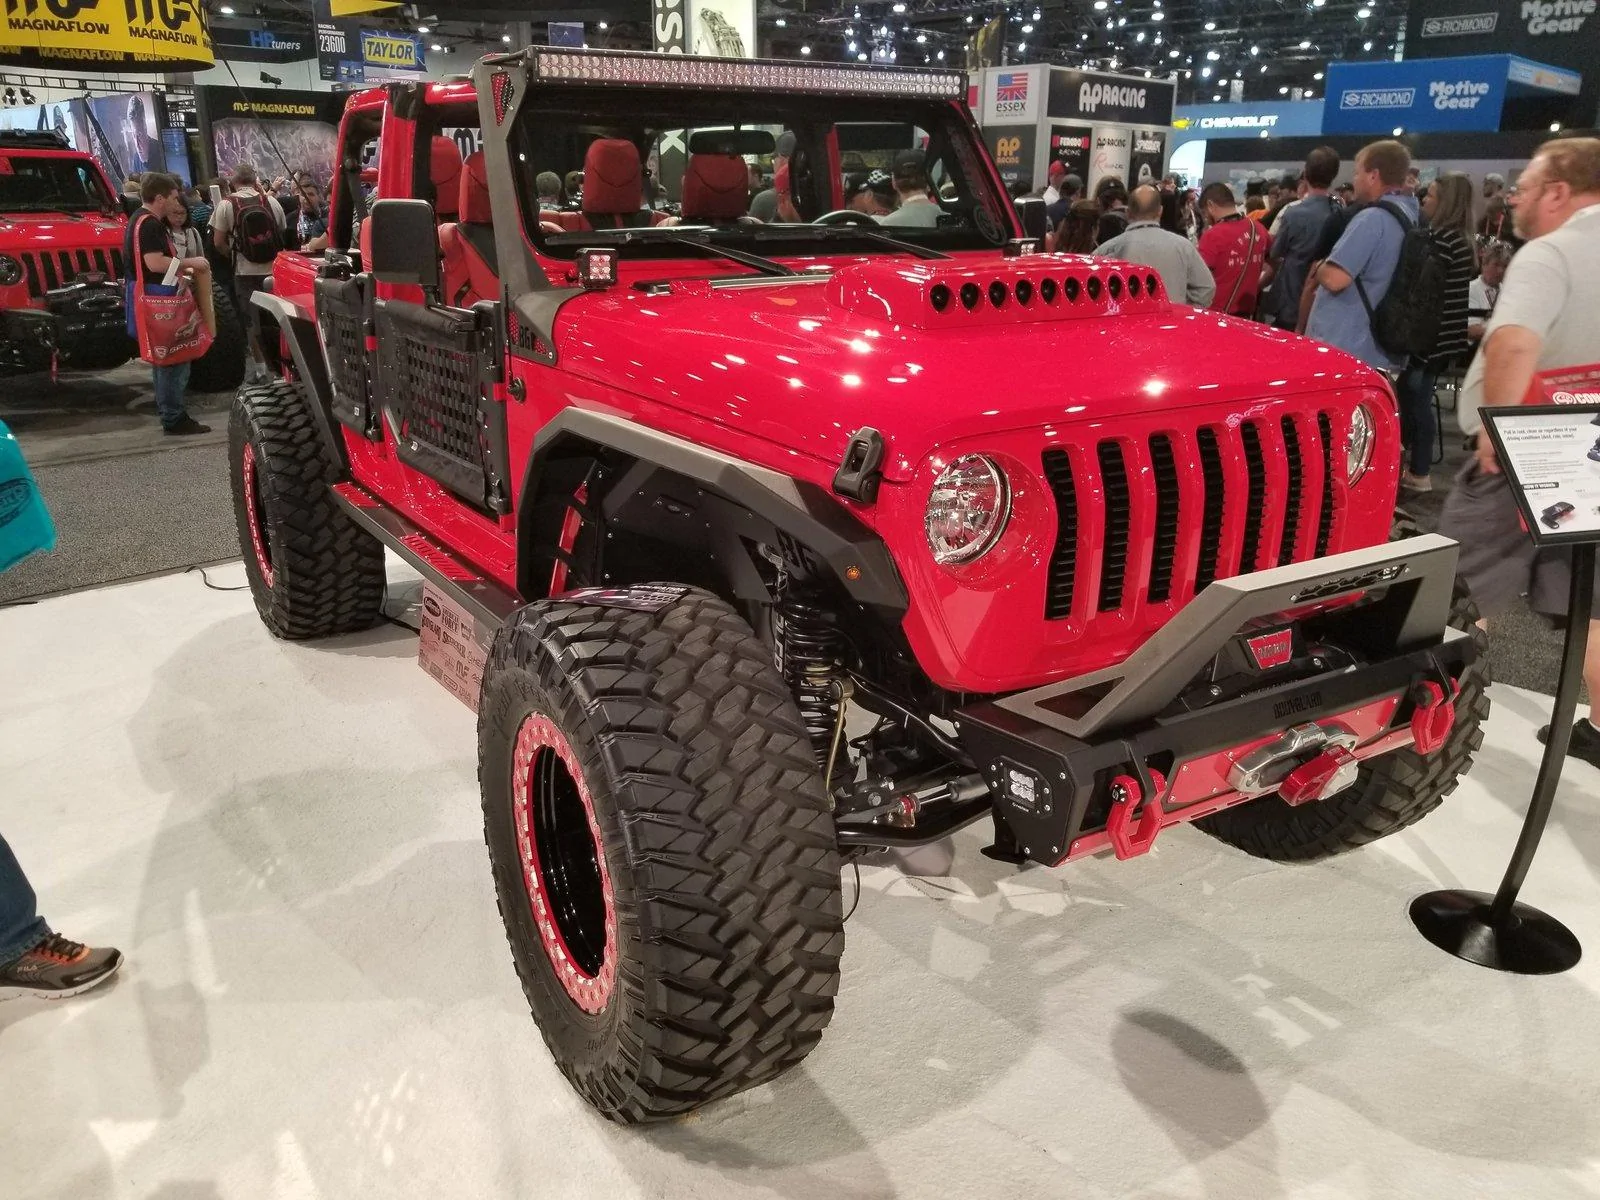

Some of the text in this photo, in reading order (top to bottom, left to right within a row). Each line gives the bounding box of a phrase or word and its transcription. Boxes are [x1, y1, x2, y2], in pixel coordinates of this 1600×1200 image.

[1521, 0, 1597, 20] Motive
[8, 18, 110, 35] MAGNAFLOW
[1442, 16, 1494, 33] RICHMOND
[1528, 16, 1586, 36] Gear
[129, 26, 198, 46] MAGNAFLOW
[250, 30, 301, 51] HP tuners
[319, 35, 346, 53] 23600
[39, 46, 125, 61] MAGNAFLOW
[367, 41, 413, 60] TAYLOR
[1079, 82, 1147, 112] AP RACING
[1428, 79, 1490, 97] Motive
[996, 102, 1026, 112] essex
[1360, 91, 1412, 107] RICHMOND
[1434, 95, 1480, 110] Gear
[251, 103, 315, 115] MAGNAFLOW
[1200, 115, 1279, 129] CHEVROLET
[997, 137, 1021, 157] AP
